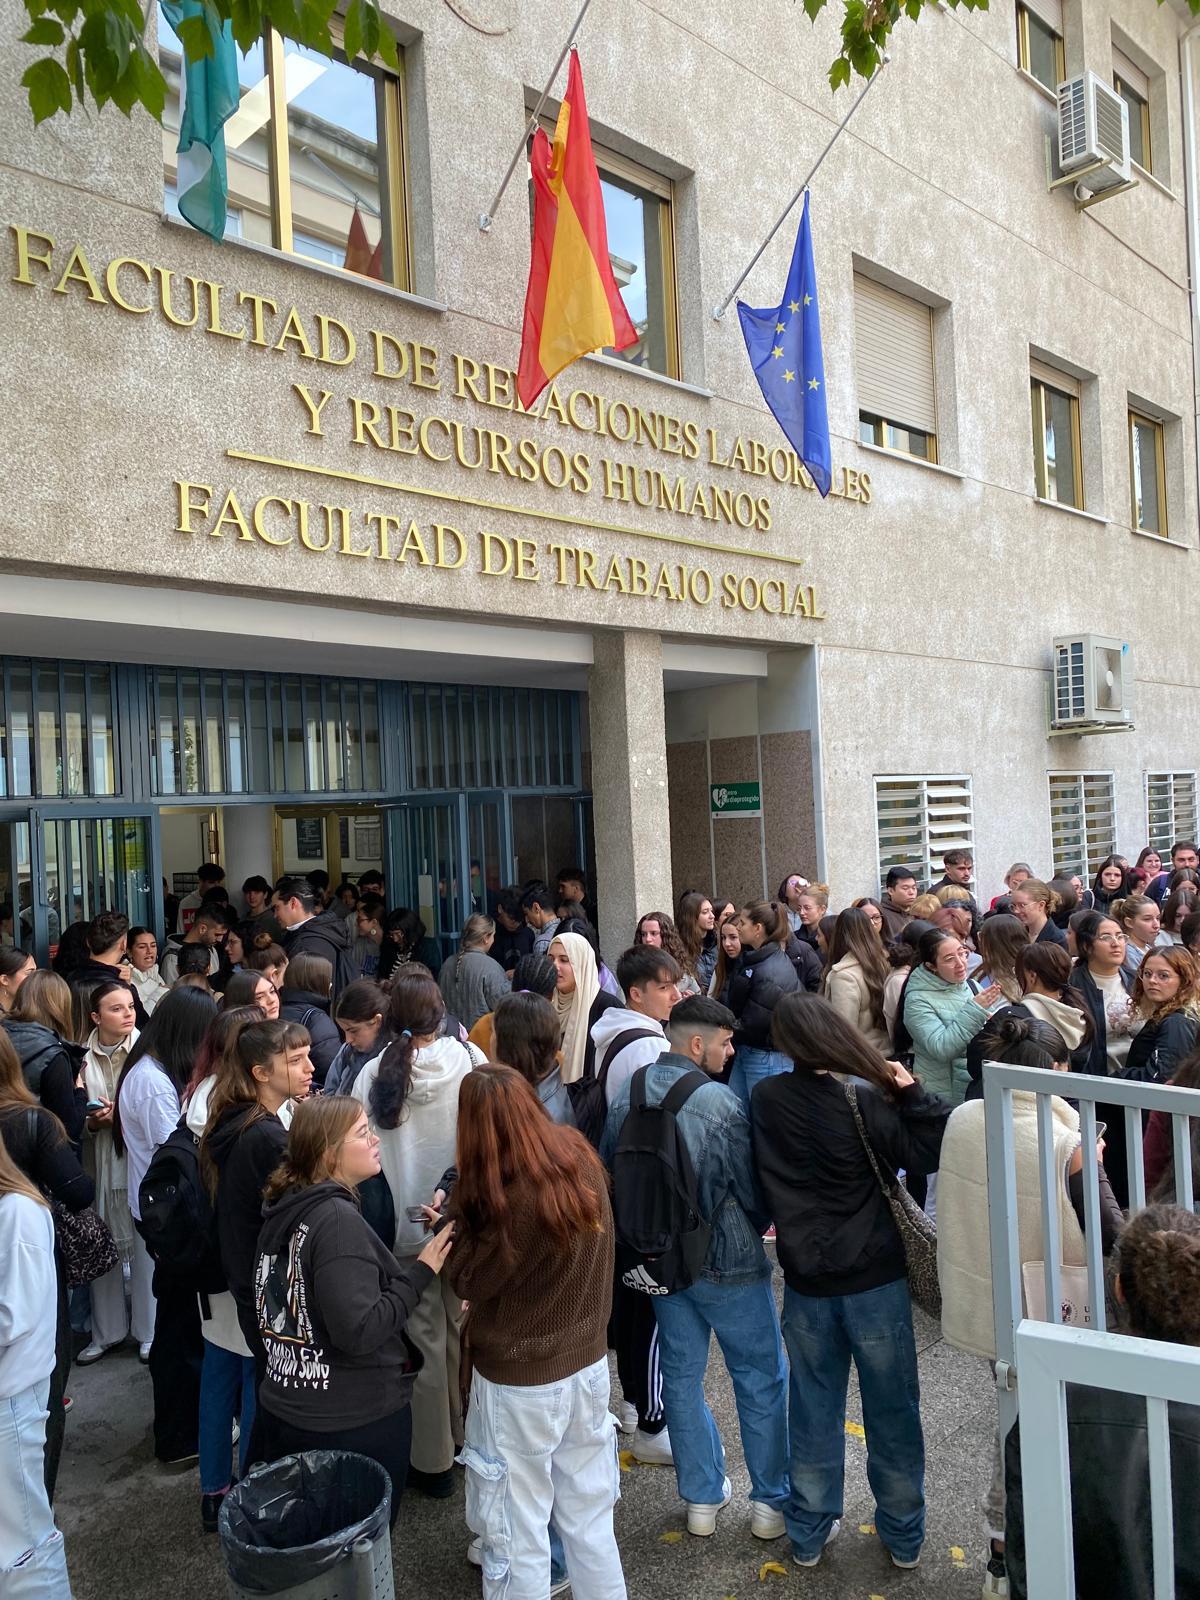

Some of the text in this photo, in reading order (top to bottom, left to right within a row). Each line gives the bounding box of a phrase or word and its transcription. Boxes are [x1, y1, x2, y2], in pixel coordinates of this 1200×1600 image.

[9, 224, 357, 367] FACULTAD
[370, 328, 441, 391] DE
[293, 383, 773, 531] Y RECURSOS HUMANOS
[174, 480, 827, 619] FACULTAD DE TRABAJO SOCIAL
[622, 1275, 669, 1295] adidas
